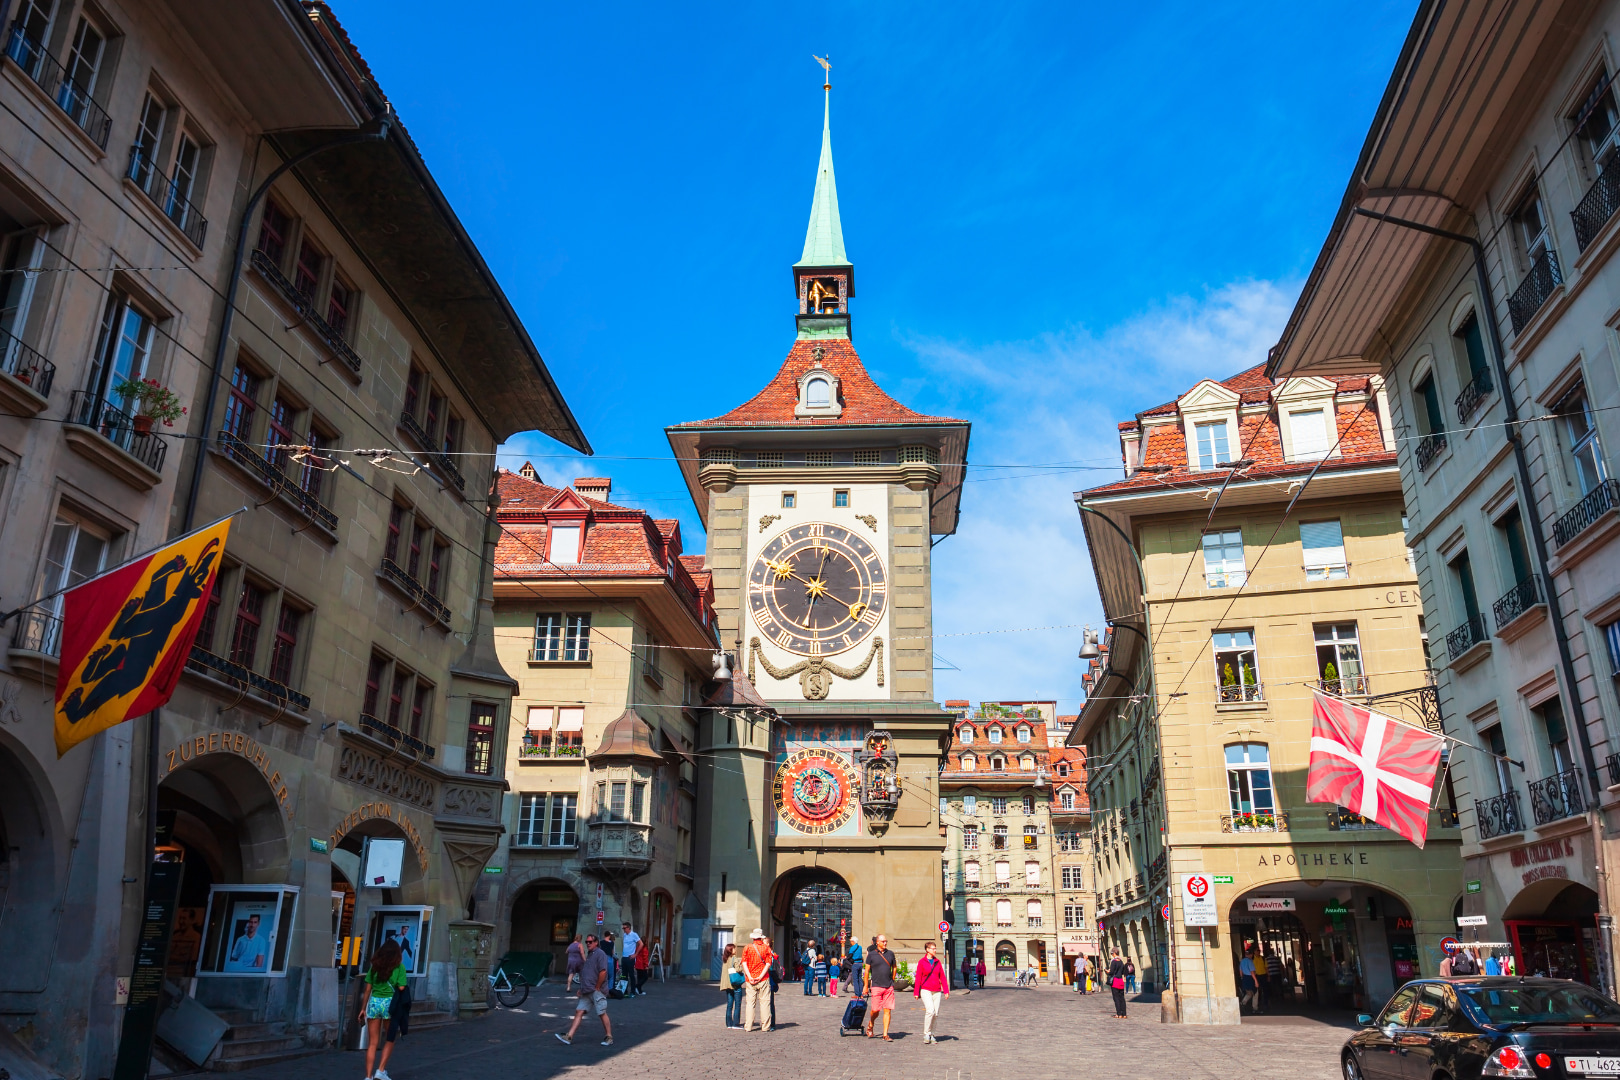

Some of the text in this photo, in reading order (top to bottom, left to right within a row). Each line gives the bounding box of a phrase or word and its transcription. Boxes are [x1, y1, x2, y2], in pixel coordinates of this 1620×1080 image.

[808, 524, 824, 536] XII
[871, 582, 886, 593] III
[1258, 852, 1369, 867] APOTHEKE
[1252, 901, 1282, 910] AMAVITA
[1578, 1059, 1590, 1070] TI
